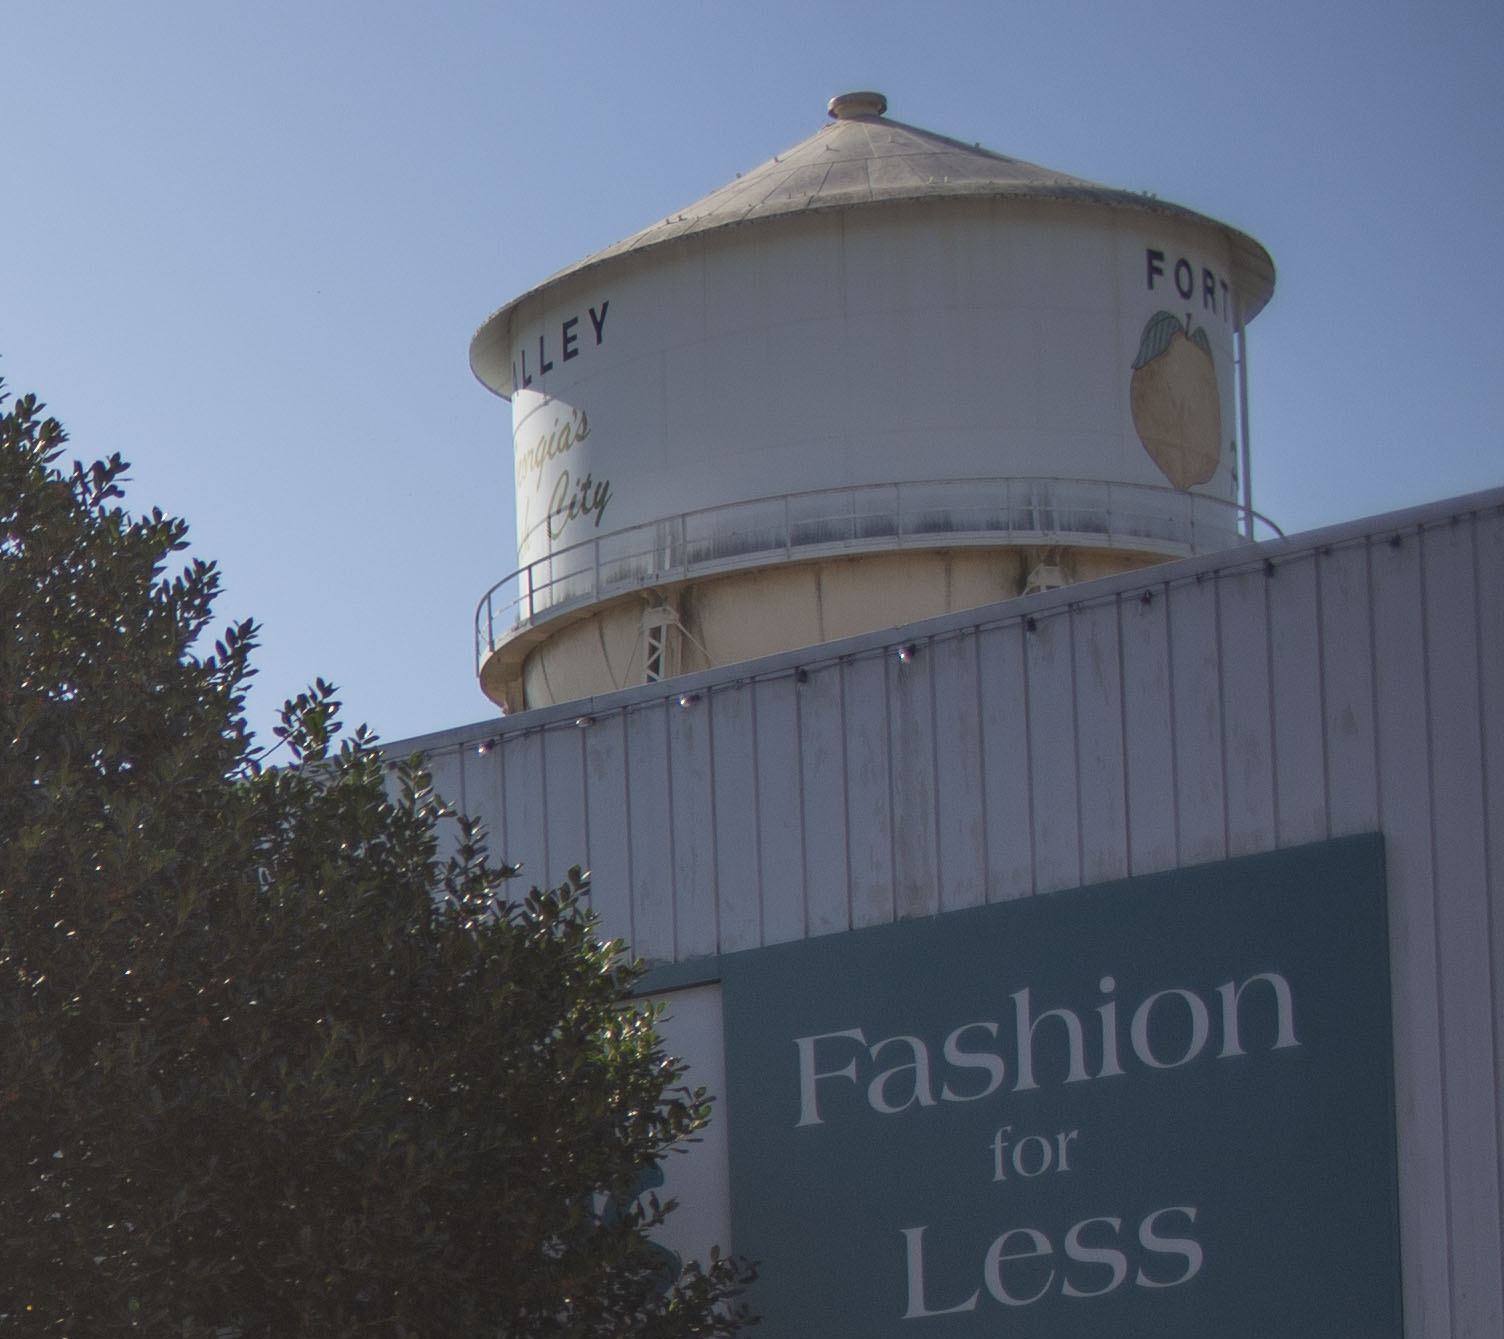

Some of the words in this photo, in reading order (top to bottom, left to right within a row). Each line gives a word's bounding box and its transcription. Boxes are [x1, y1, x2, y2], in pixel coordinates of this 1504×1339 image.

[1146, 248, 1230, 322] FORT
[546, 469, 613, 541] City
[793, 969, 1302, 1130] Fashion
[989, 1126, 1078, 1182] for
[899, 1205, 1204, 1320] Less
